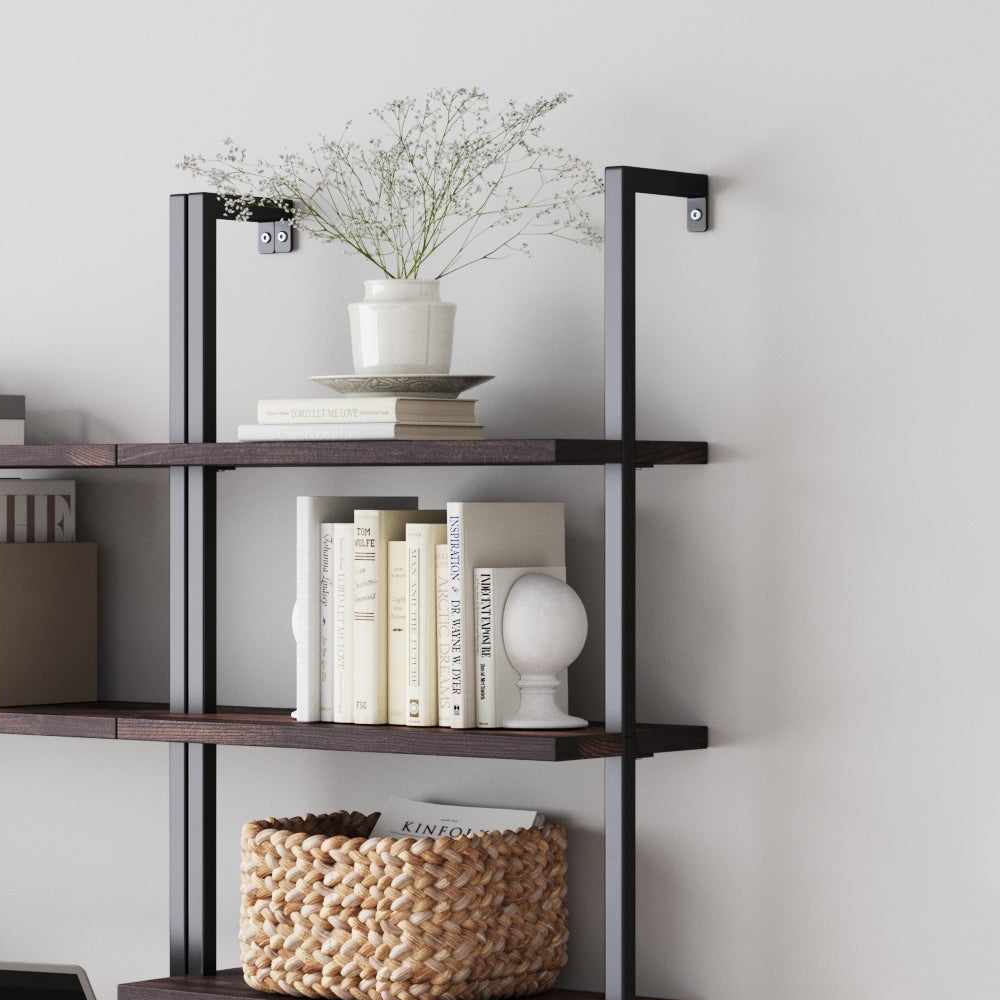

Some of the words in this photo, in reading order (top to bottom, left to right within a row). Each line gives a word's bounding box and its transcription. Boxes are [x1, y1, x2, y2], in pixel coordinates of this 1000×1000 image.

[313, 408, 326, 418] LET
[327, 408, 339, 418] ME
[340, 407, 359, 418] LOVE
[354, 538, 376, 548] WOLFE
[357, 527, 371, 536] TOM
[321, 533, 332, 575] Johanna
[449, 515, 460, 581] INSPIRATION
[480, 573, 491, 616] INDECENT
[337, 604, 345, 623] LET
[437, 577, 449, 638] ARCTIC
[337, 626, 345, 643] ME
[452, 619, 461, 653] WAYNE
[480, 616, 491, 658] EXPOSURE
[337, 645, 345, 669] LOVE
[439, 641, 450, 710] DREAMS
[452, 668, 461, 695] DYER
[356, 701, 367, 710] FSG
[401, 820, 490, 838] KINFO
